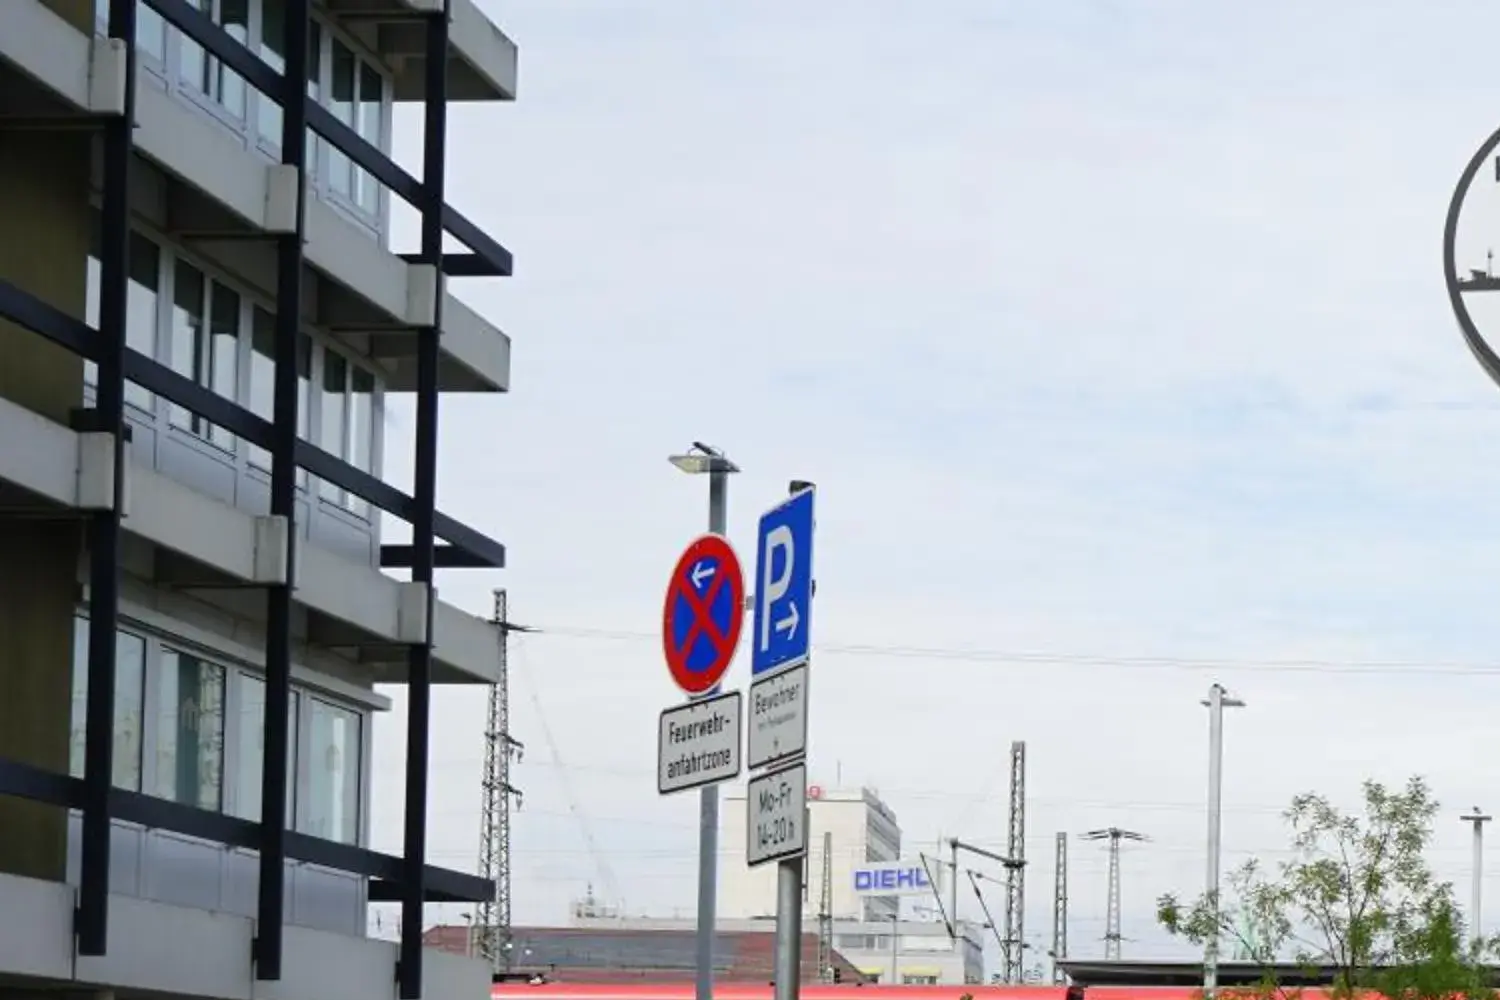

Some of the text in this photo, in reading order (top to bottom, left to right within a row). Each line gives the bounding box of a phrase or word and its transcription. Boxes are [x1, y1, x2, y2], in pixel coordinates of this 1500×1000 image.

[761, 525, 794, 652] P
[755, 682, 800, 715] Bewohner
[669, 711, 731, 745] Feuerwehr-
[667, 748, 731, 779] anfahrtzone
[759, 781, 792, 814] Mo-Fr
[855, 867, 929, 890] DIEHL
